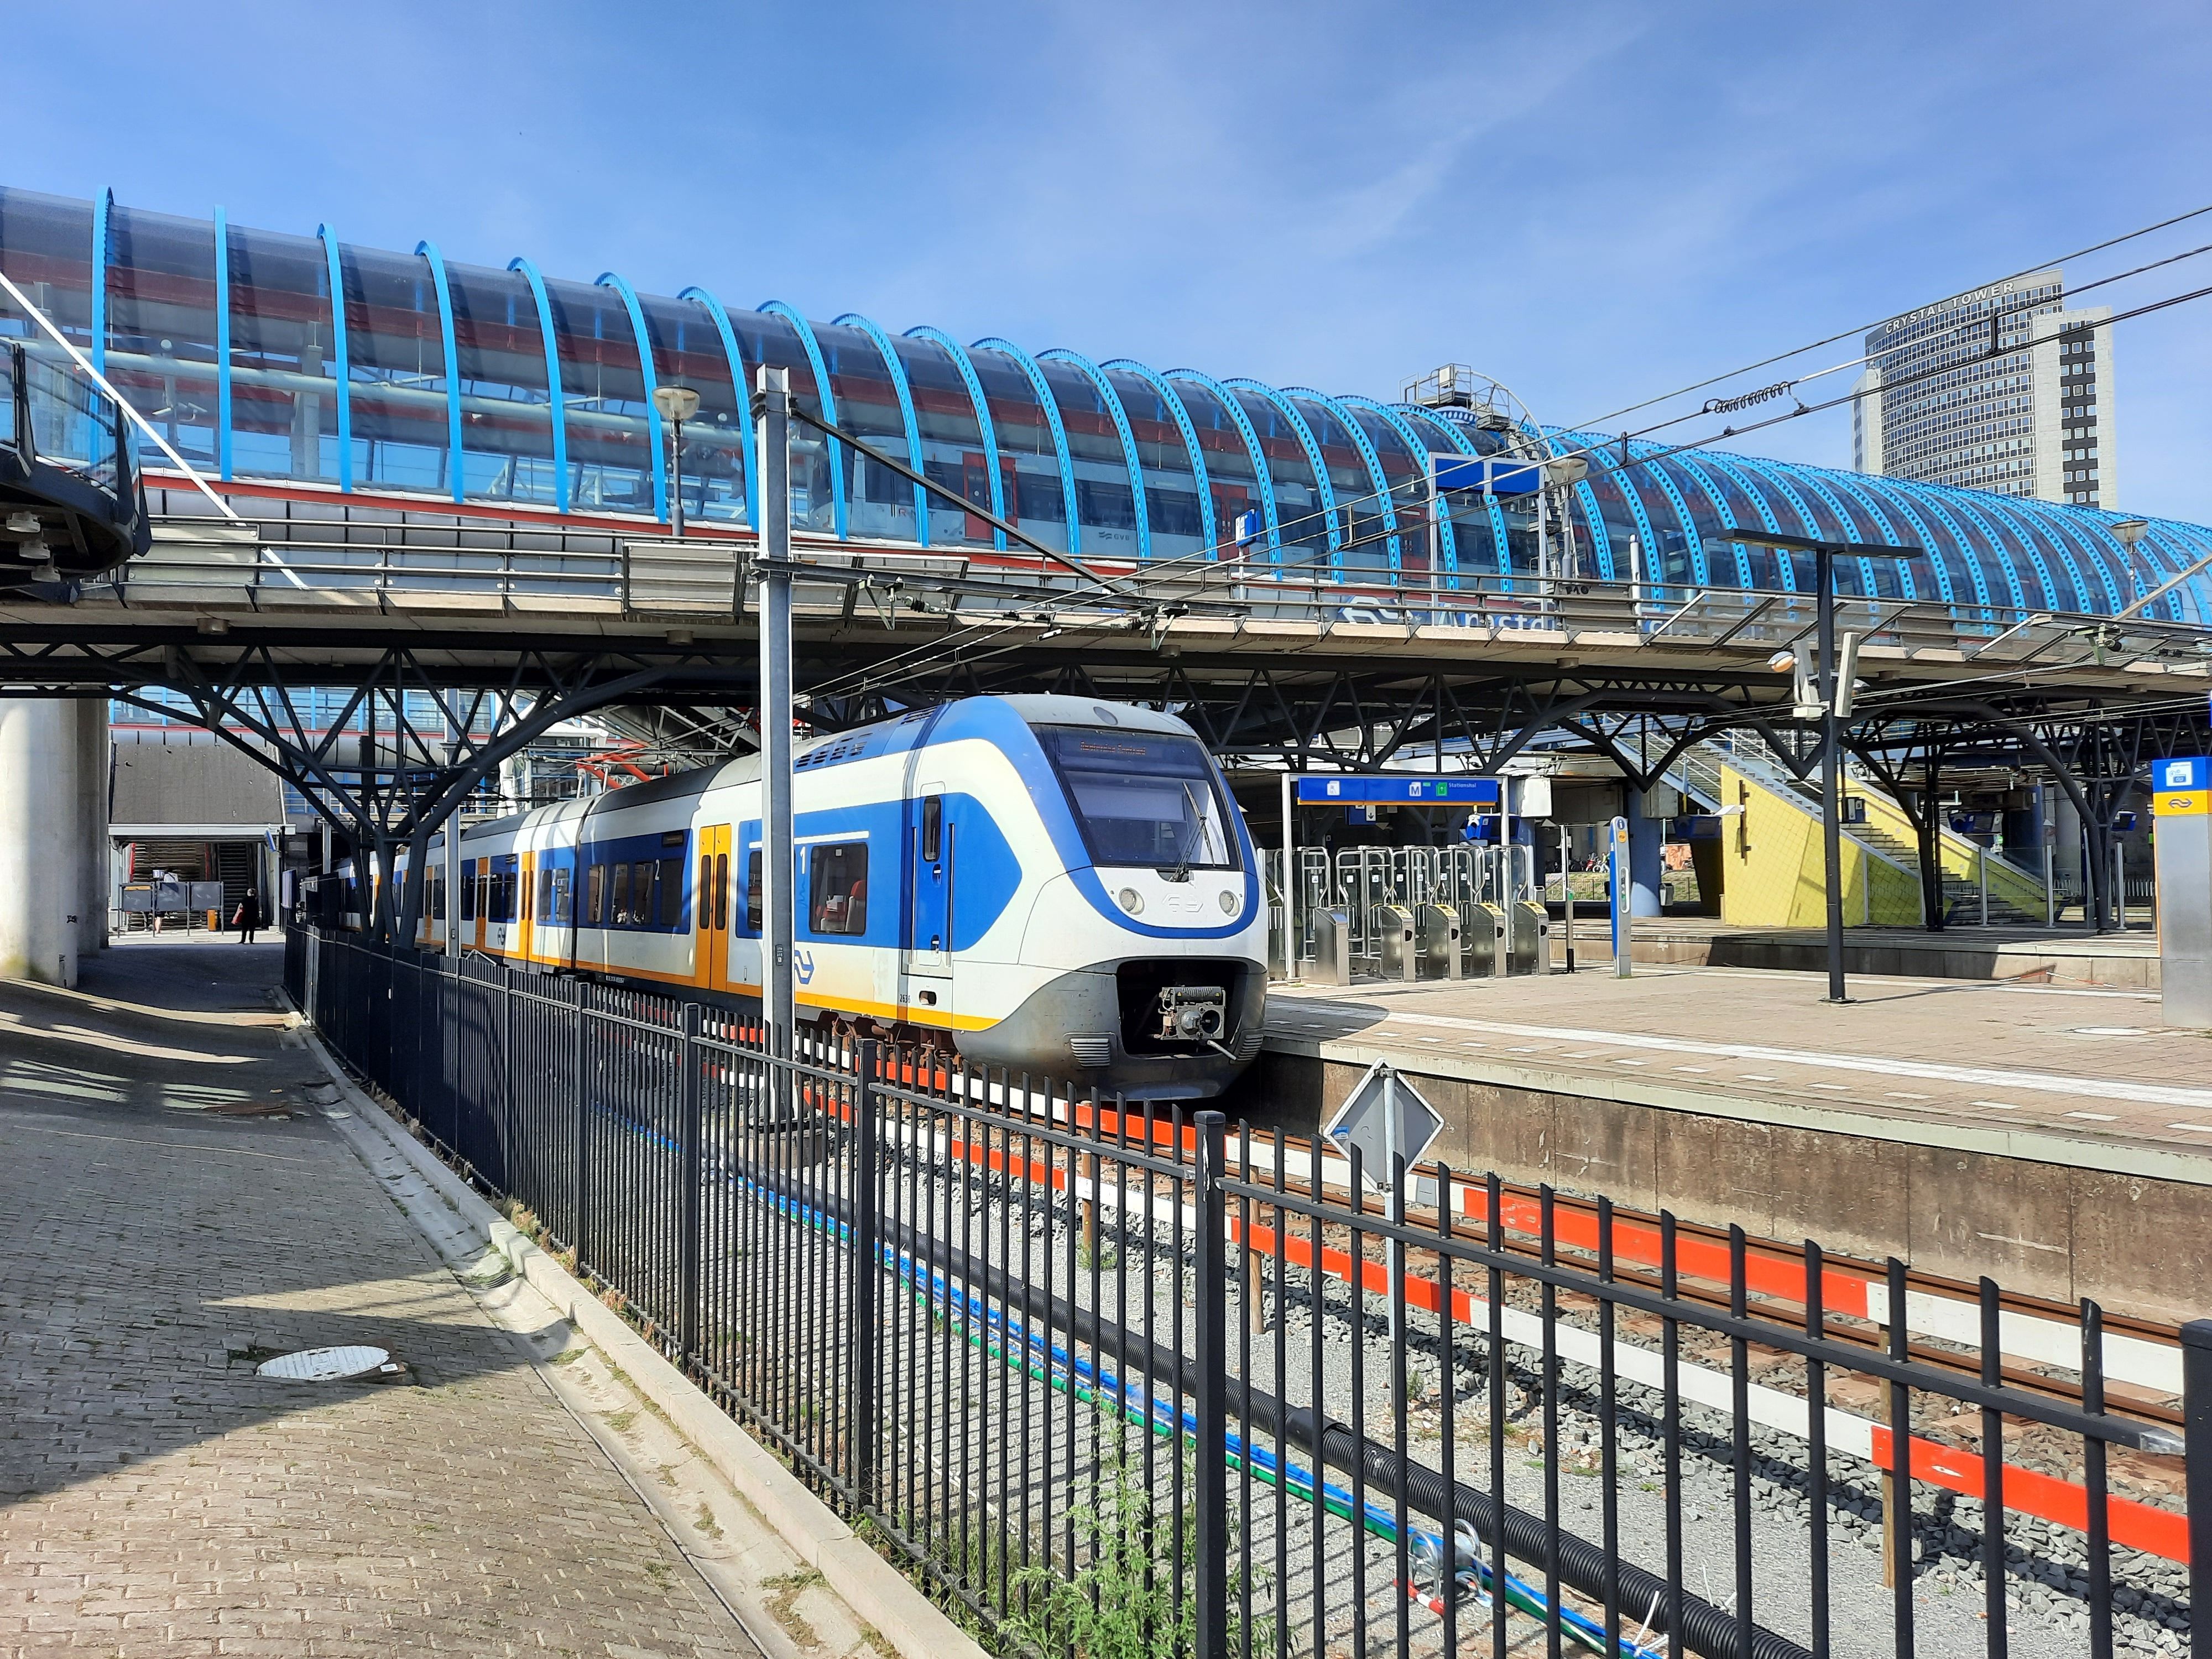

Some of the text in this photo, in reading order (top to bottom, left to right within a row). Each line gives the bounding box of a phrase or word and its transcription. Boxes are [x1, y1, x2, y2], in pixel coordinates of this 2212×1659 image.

[1885, 282, 2014, 335] CRYSTAL TOWER
[1411, 786, 1420, 795] M
[655, 859, 660, 880] 2
[800, 846, 805, 874] 1
[900, 994, 911, 1004] 2636
